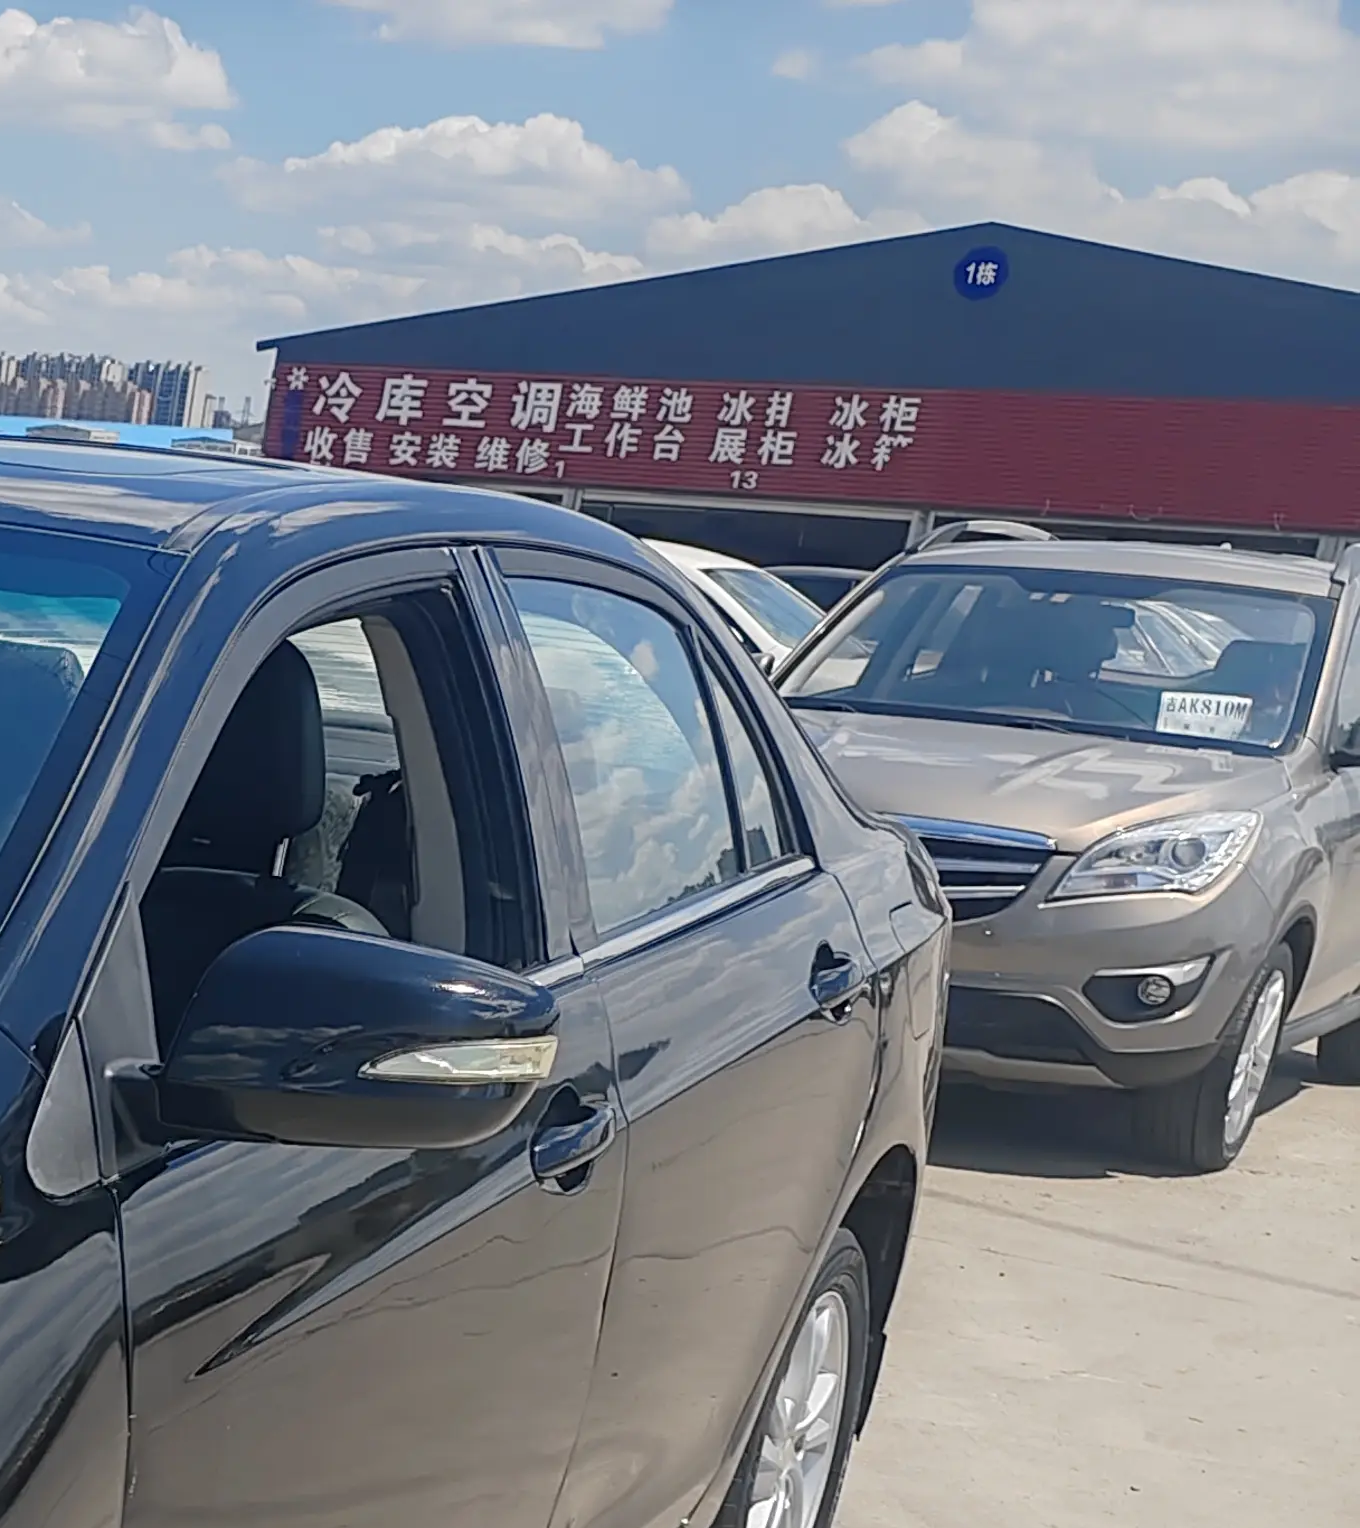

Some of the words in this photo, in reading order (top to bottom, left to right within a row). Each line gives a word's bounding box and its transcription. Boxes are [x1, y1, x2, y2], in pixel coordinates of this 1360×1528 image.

[312, 371, 563, 433] 冷库空调
[565, 383, 693, 424] 海鲜池
[829, 393, 921, 432] 冰柜
[304, 426, 373, 465] 收售
[389, 432, 461, 469] 安装
[474, 436, 550, 474] 维修
[559, 421, 686, 462] 工作台
[708, 428, 797, 465] 展柜
[729, 470, 759, 489] 13
